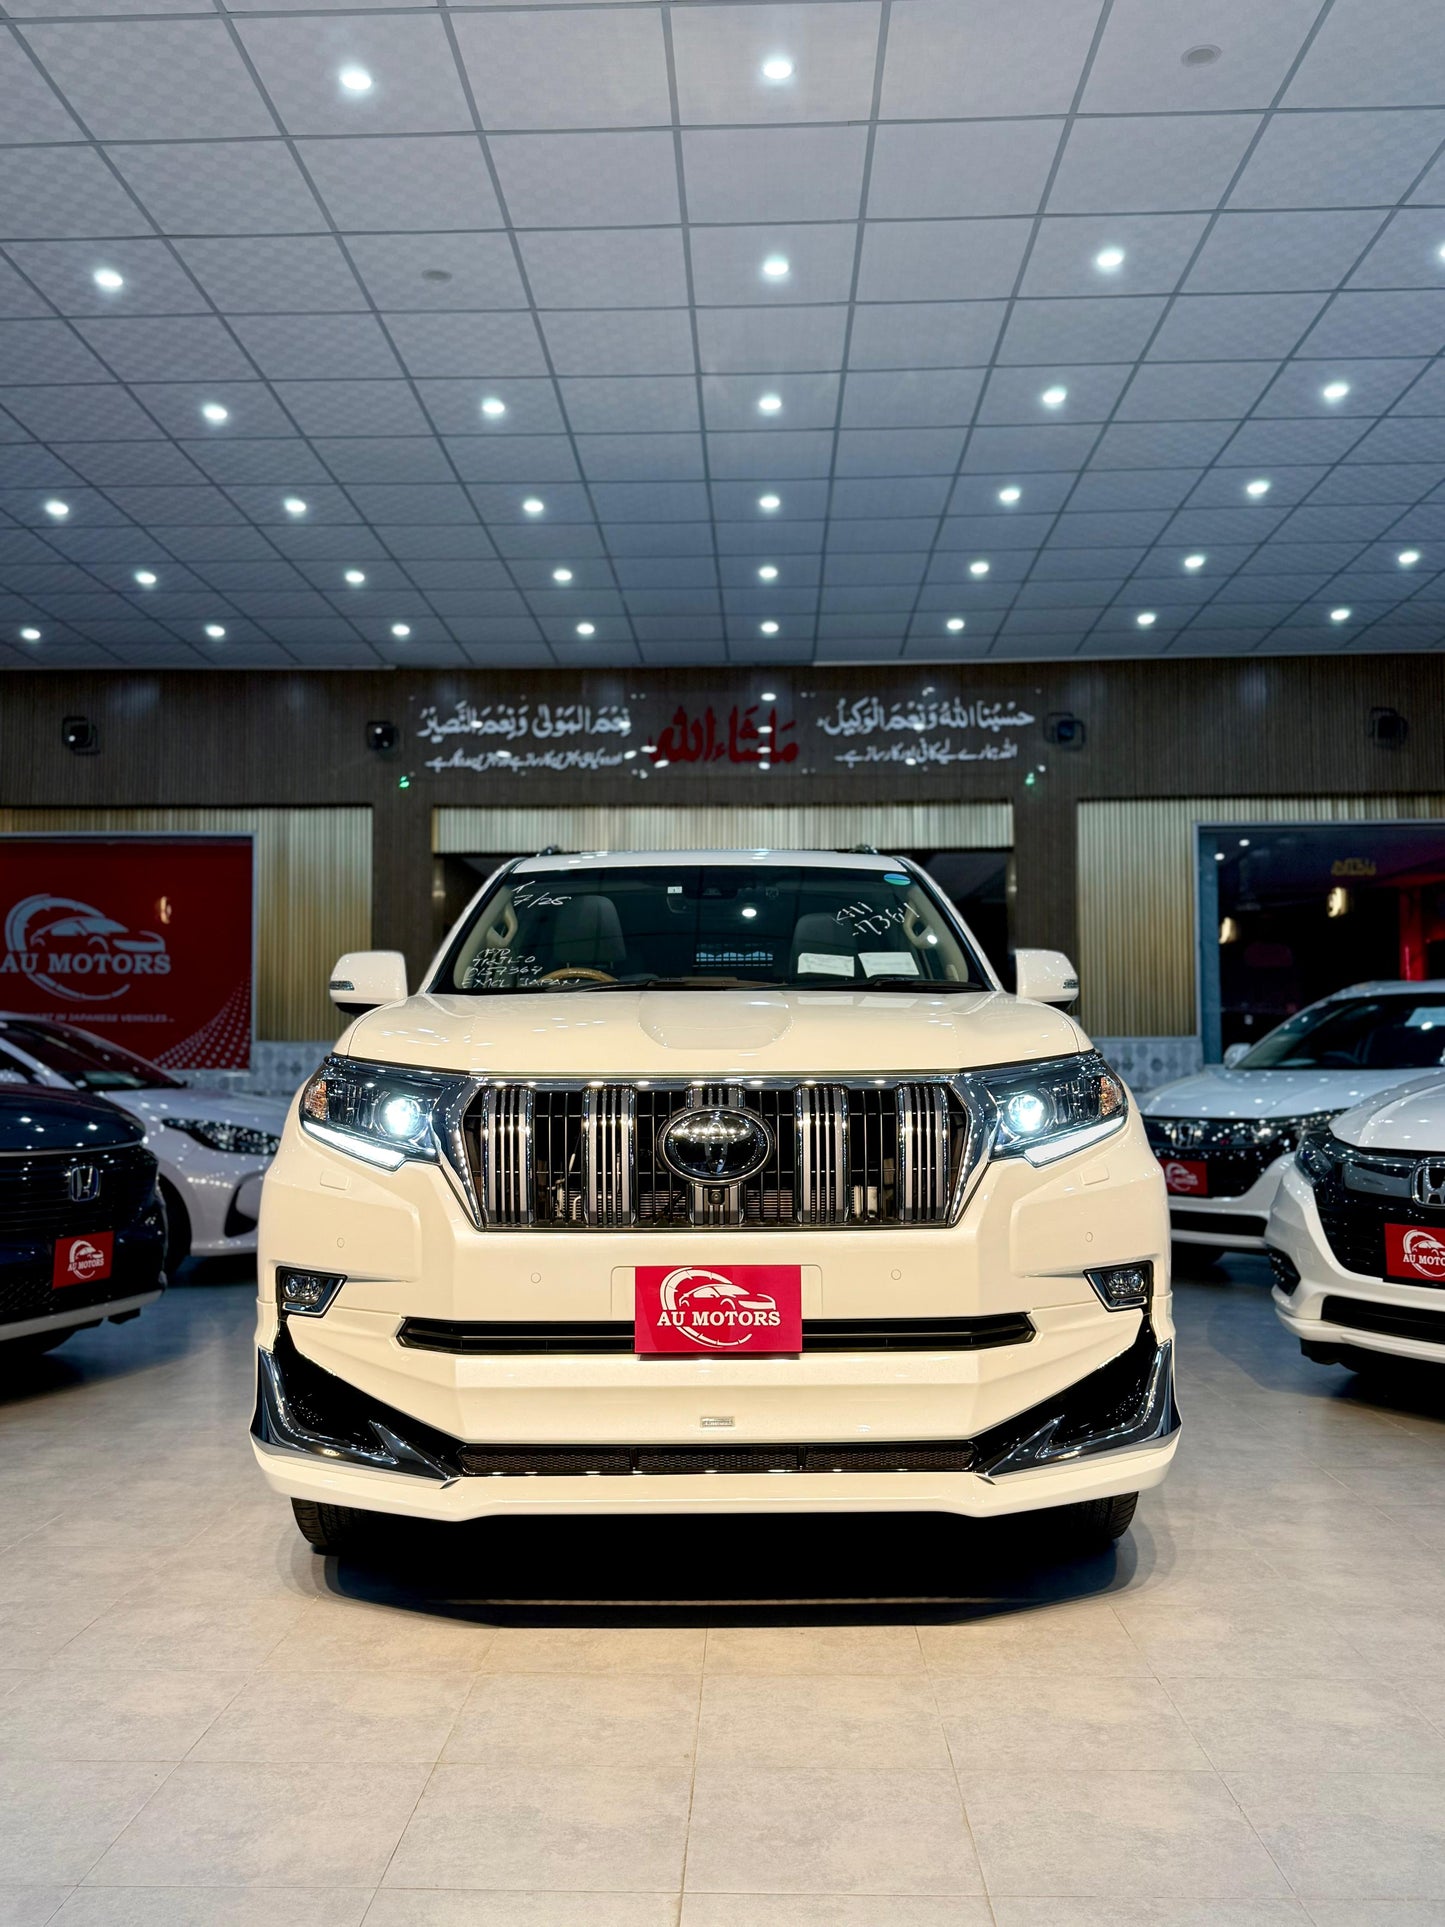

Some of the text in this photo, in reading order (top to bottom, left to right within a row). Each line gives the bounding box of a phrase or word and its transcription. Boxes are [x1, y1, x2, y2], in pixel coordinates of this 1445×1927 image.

[0, 953, 171, 975] AU MOTORS
[67, 1258, 105, 1272] AU MOTORS
[1403, 1254, 1445, 1267] AU MOTO
[656, 1311, 781, 1327] AU MOTORS
